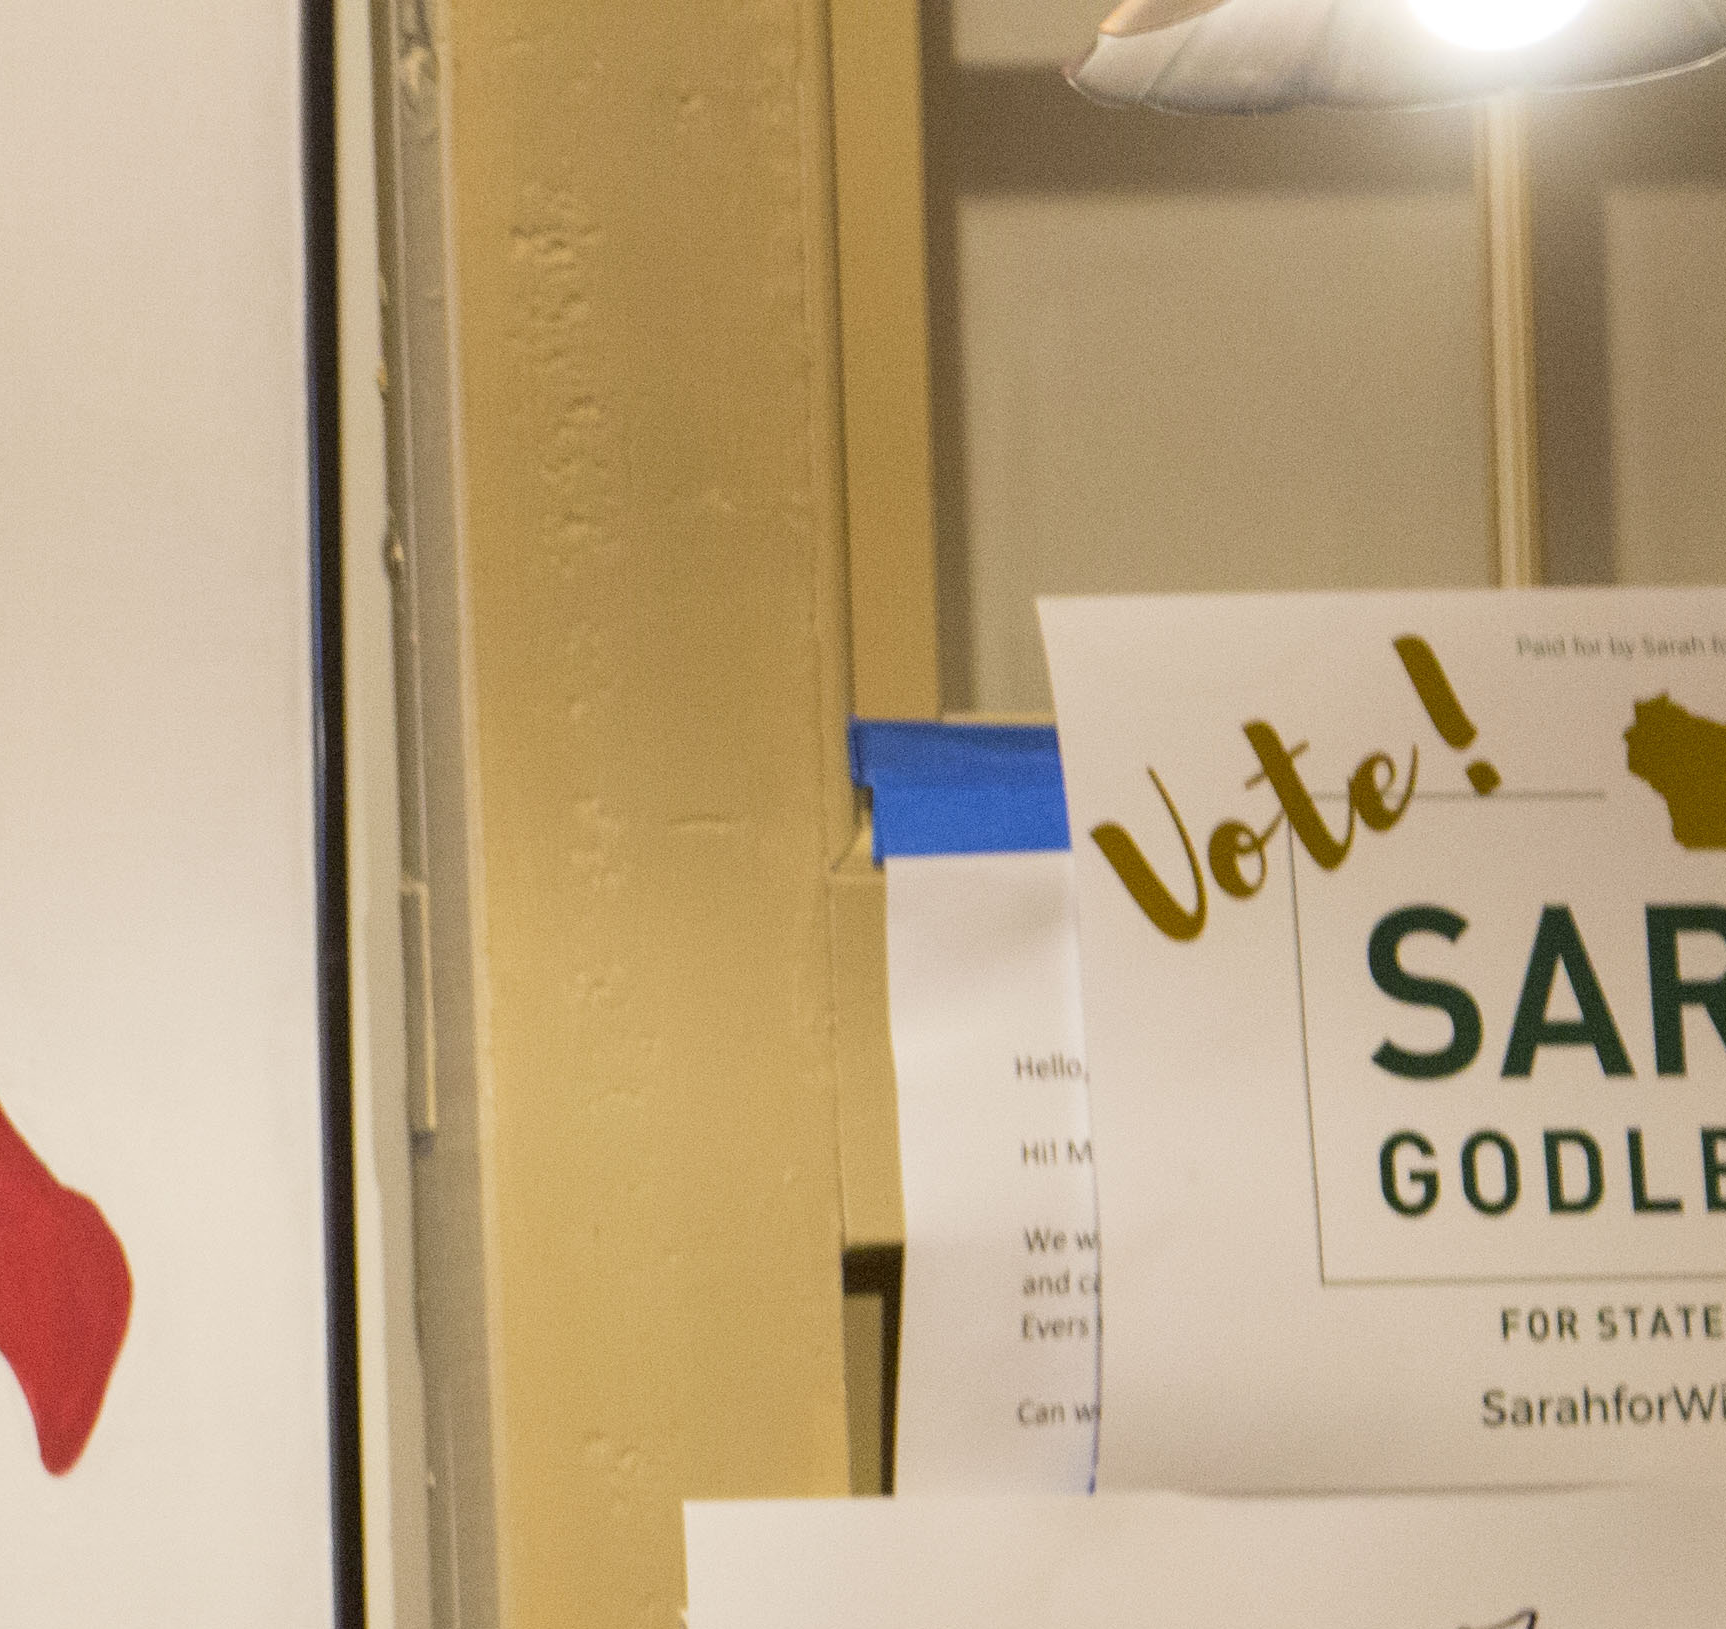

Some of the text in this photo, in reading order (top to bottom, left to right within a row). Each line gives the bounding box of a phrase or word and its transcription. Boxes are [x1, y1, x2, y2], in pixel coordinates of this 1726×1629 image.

[1090, 633, 1502, 942] Vote!
[1367, 903, 1726, 1080] SAR
[1024, 1228, 1068, 1253] We
[1022, 1267, 1071, 1296] and
[1500, 1304, 1724, 1342] FOR STATE
